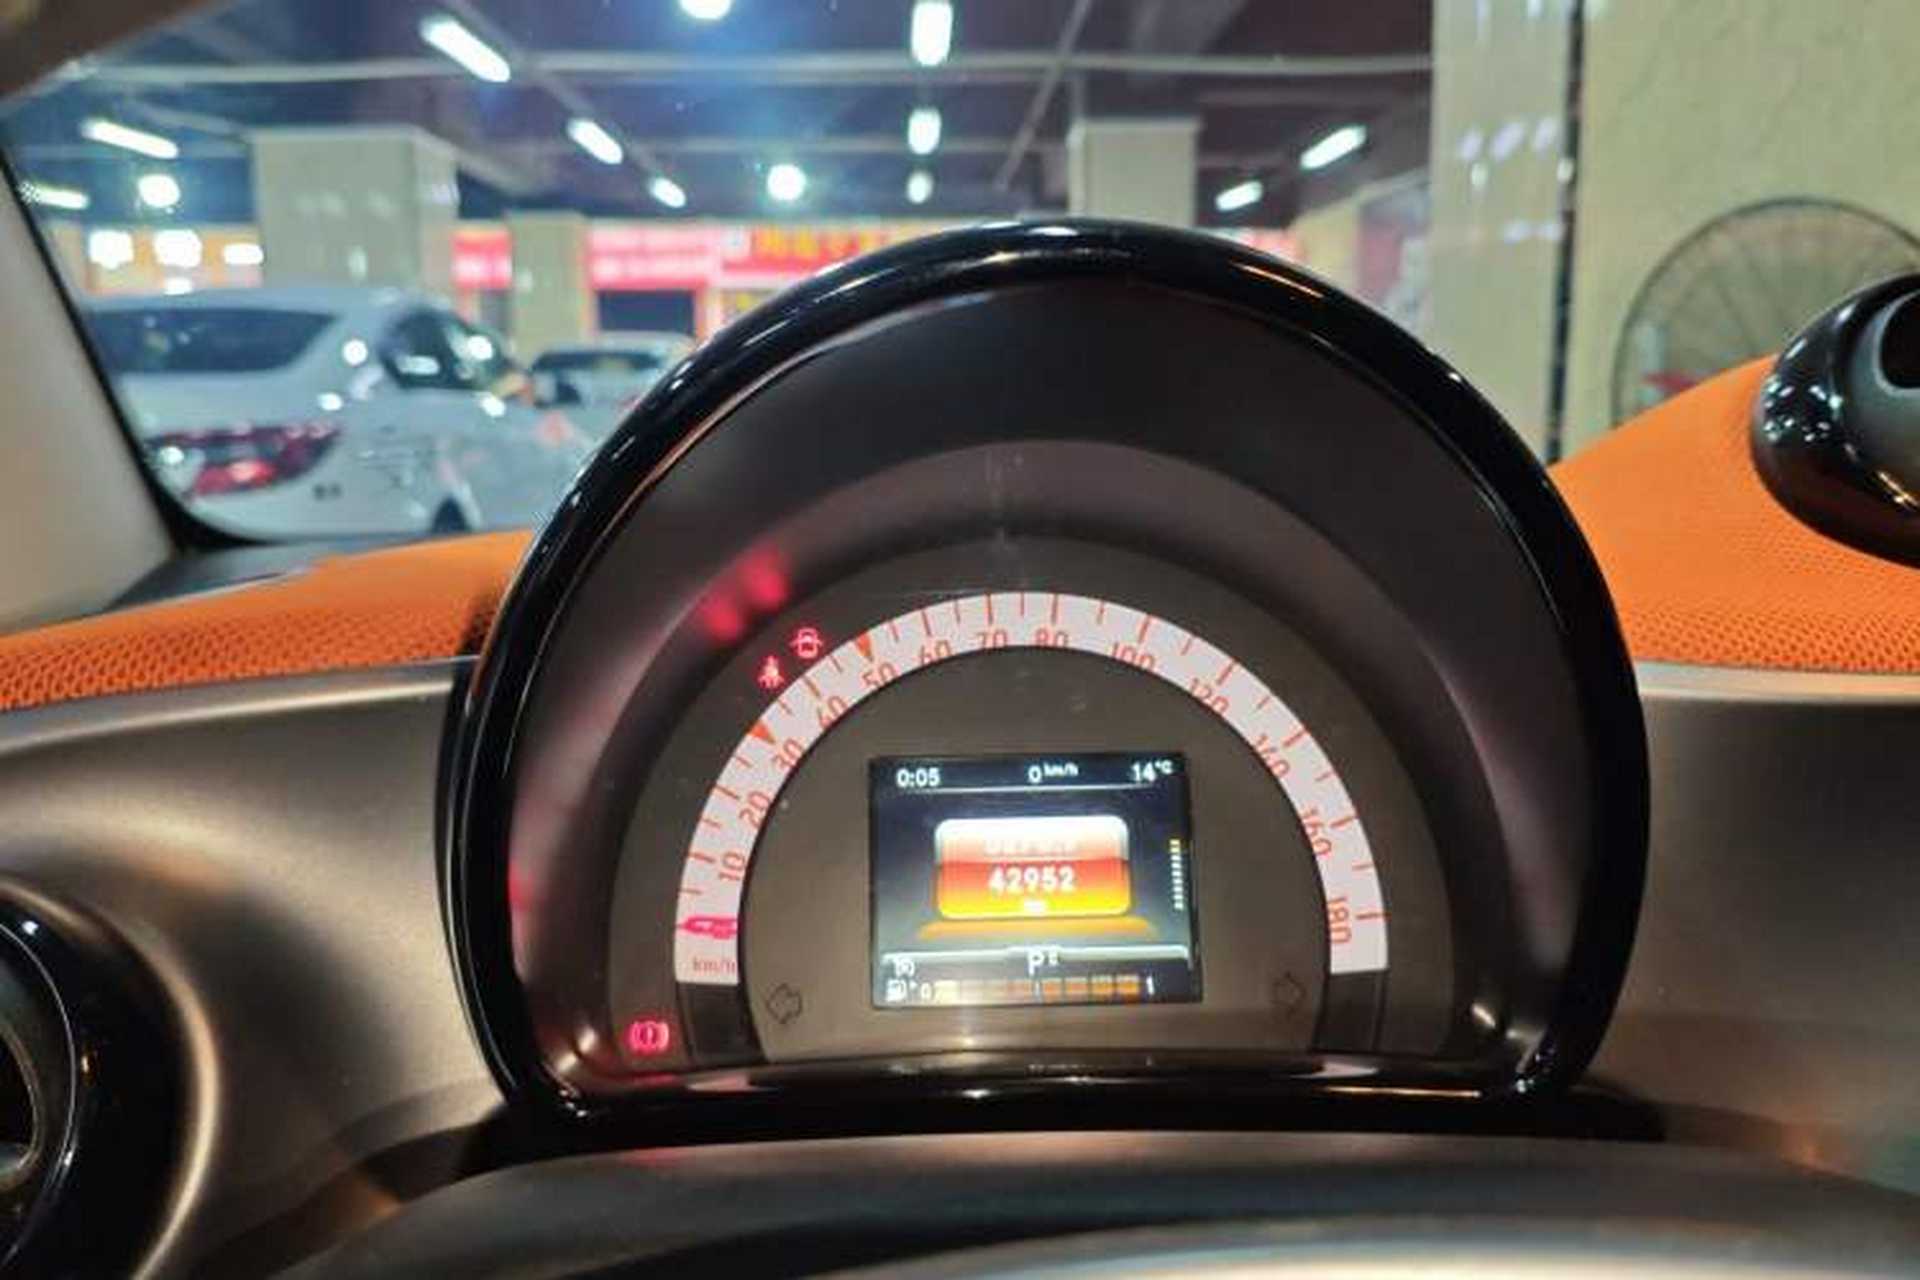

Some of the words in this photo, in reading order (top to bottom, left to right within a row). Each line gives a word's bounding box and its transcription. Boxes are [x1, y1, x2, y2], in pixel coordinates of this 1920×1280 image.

[919, 639, 951, 664] 60
[976, 629, 1008, 649] 70
[1035, 627, 1069, 648] 80
[861, 662, 897, 690] 50
[771, 739, 802, 769] 30
[896, 768, 940, 788] 0:05
[738, 791, 771, 829] 20
[718, 852, 745, 881] 10
[987, 864, 1075, 896] 42952
[1327, 897, 1352, 944] 180
